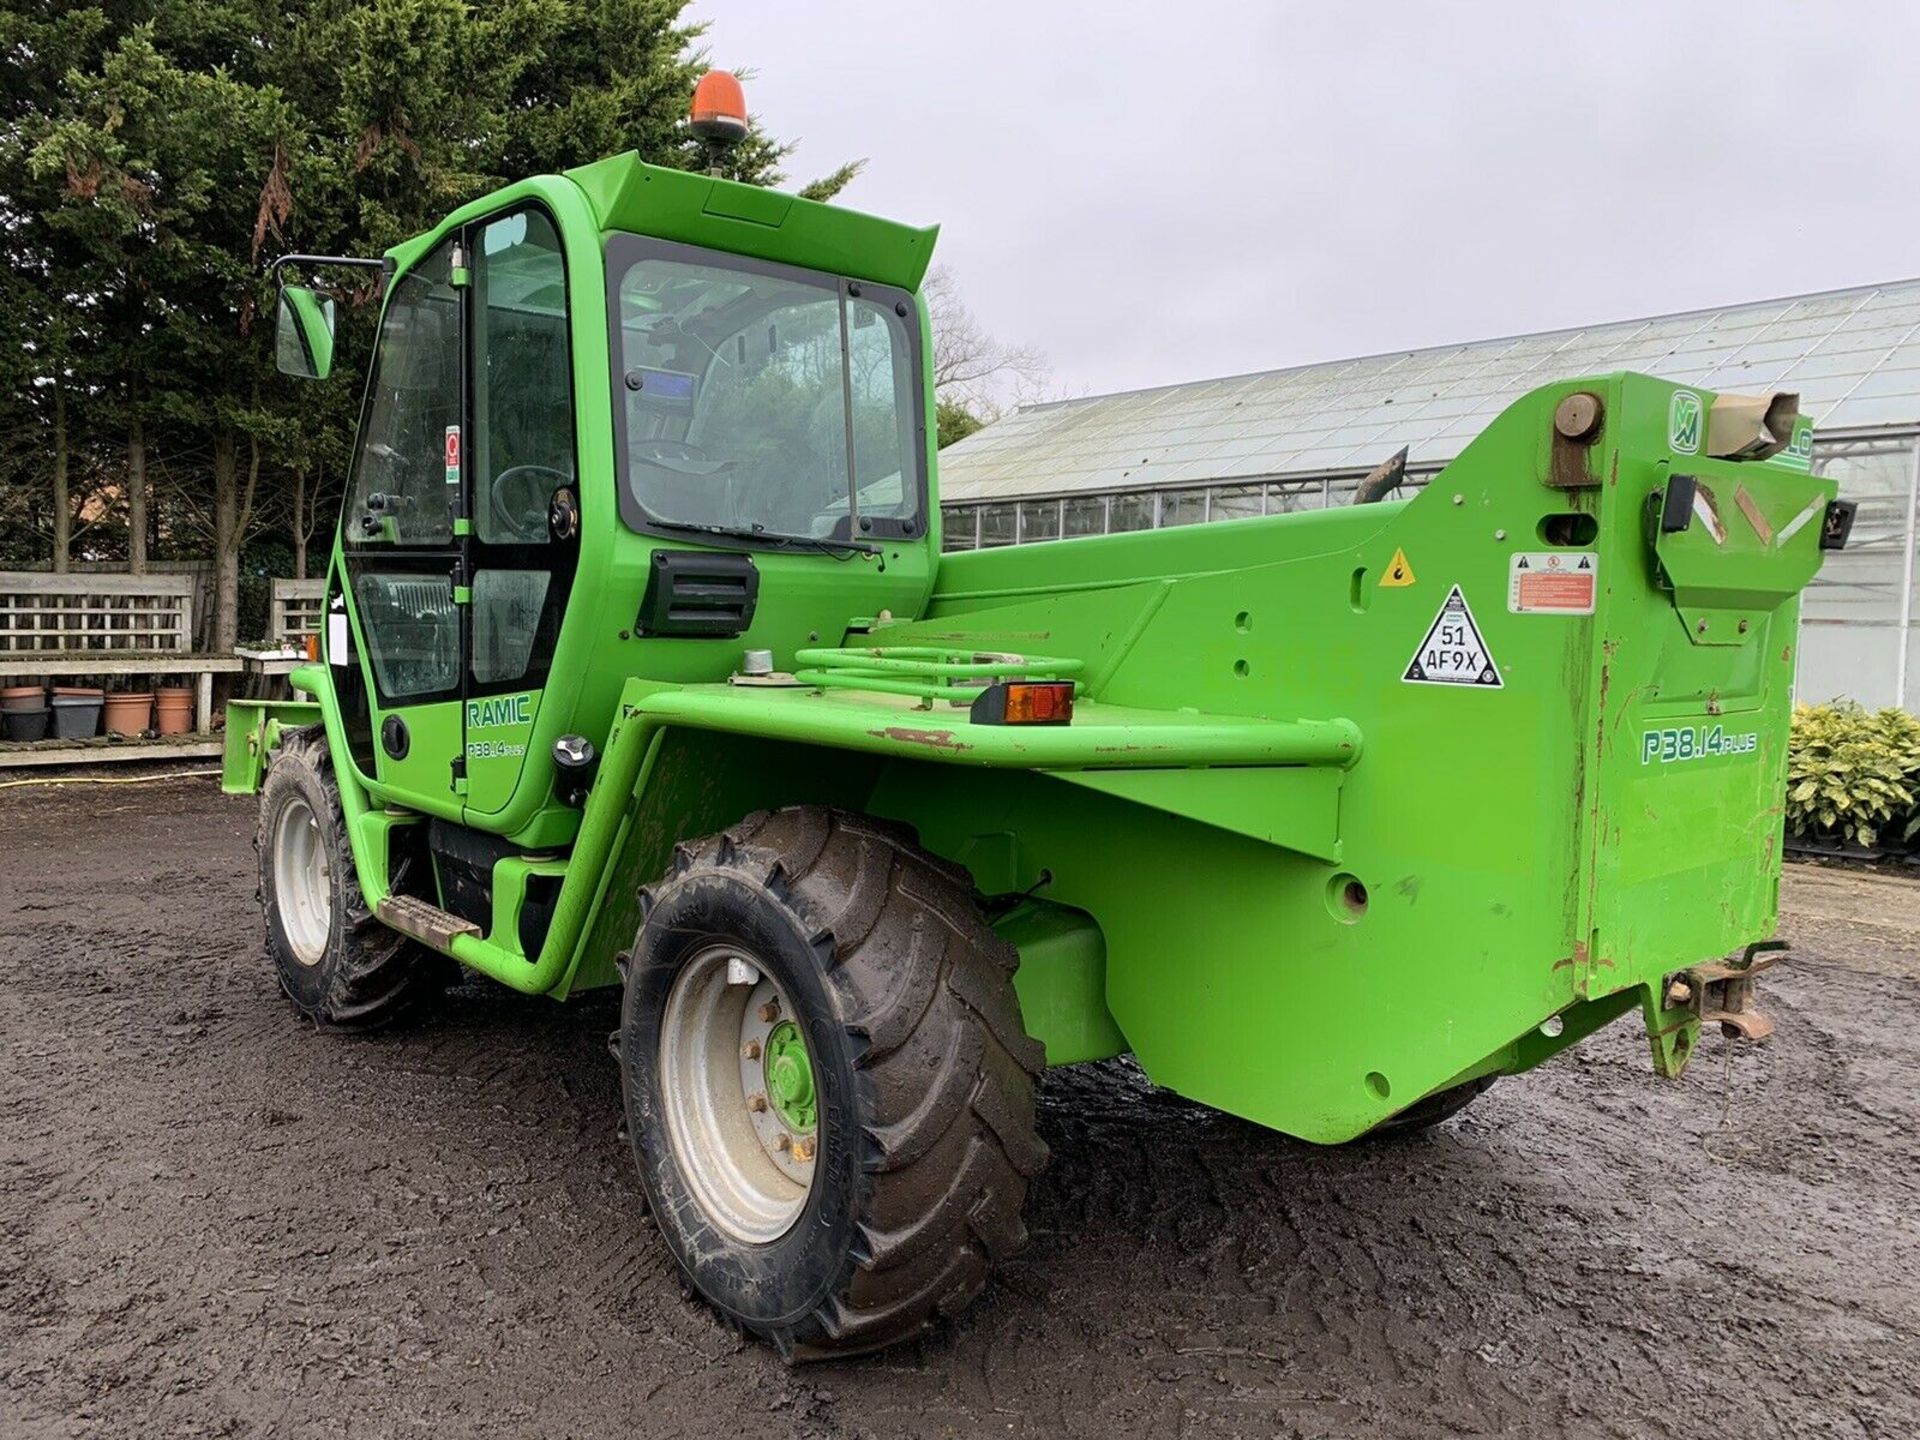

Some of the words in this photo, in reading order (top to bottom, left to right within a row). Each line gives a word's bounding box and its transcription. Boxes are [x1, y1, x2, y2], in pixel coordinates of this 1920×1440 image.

[1441, 625, 1466, 646] 51
[1426, 649, 1478, 672] AF9X
[466, 694, 531, 729] RAMIC
